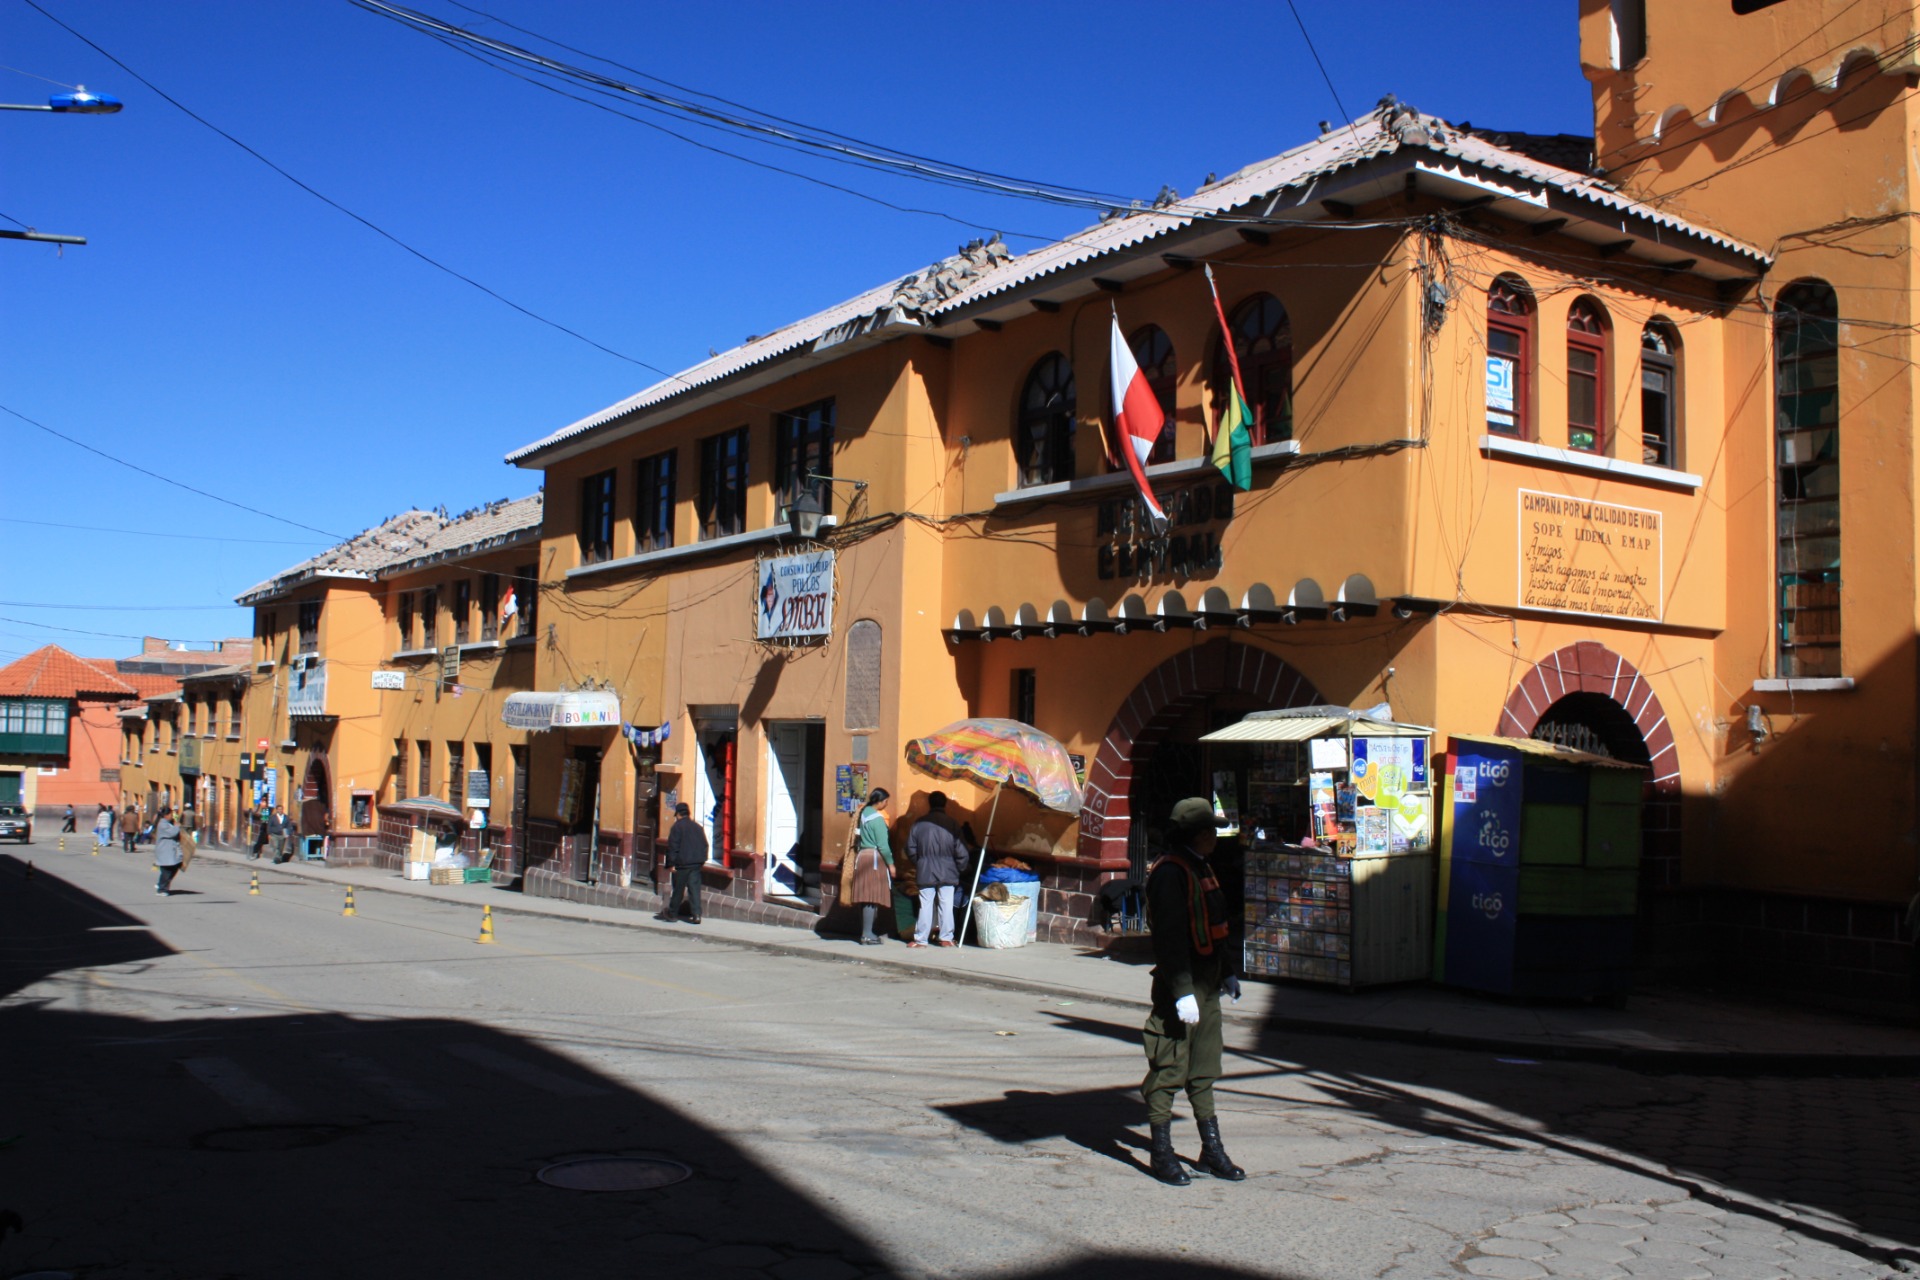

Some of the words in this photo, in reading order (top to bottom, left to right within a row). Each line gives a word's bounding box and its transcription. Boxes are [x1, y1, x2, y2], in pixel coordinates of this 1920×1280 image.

[1524, 494, 1562, 516] CAMPAÑA
[1563, 501, 1580, 518] POR
[1581, 503, 1592, 520] LA
[1594, 506, 1627, 526] CALIDAD
[1628, 511, 1639, 528] DE
[1640, 513, 1657, 531] VIDA
[1533, 521, 1563, 538] SOPE
[1575, 527, 1611, 545] LIDEMA
[1621, 534, 1651, 551] EMAP
[1600, 564, 1610, 581] de
[1613, 565, 1647, 586] nuestra
[1568, 578, 1590, 595] Villa
[1536, 594, 1567, 609] ciudad
[1616, 600, 1631, 615] del
